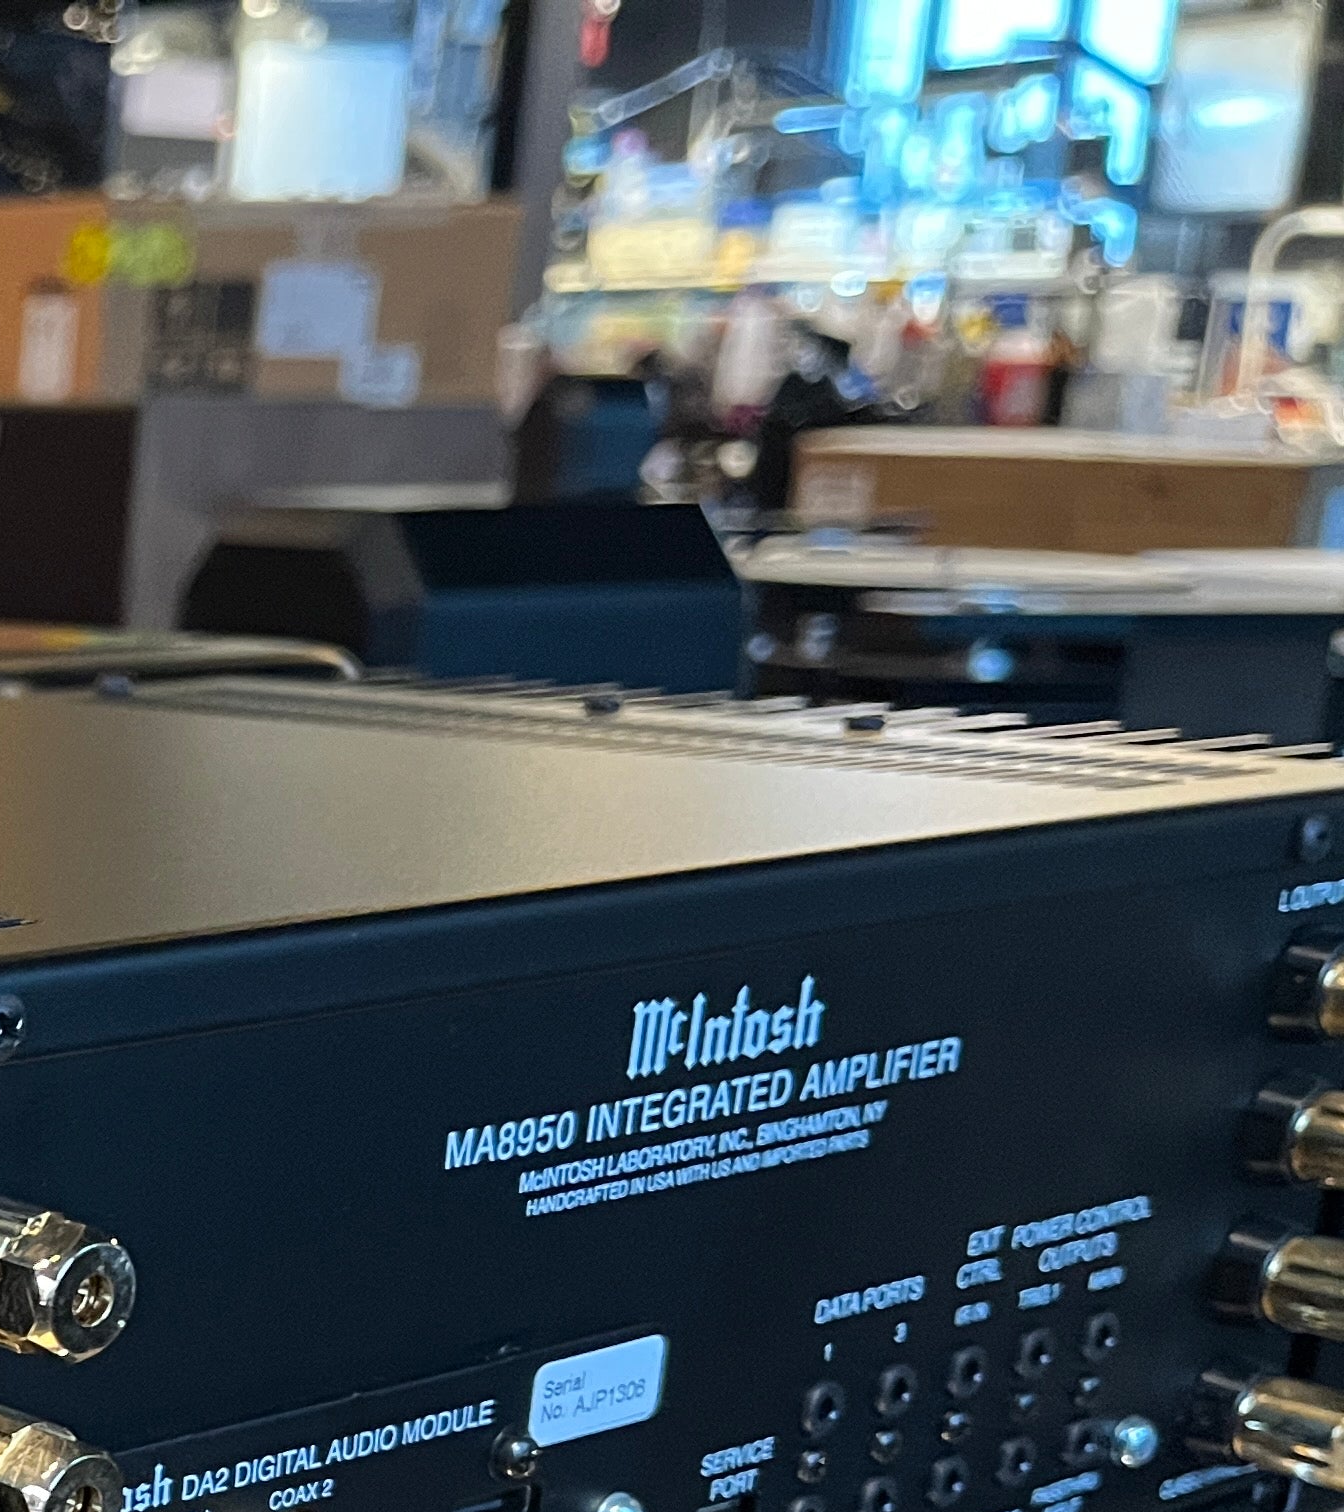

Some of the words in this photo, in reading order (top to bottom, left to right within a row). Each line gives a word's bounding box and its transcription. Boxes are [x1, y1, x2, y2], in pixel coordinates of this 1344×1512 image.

[625, 973, 826, 1080] McIntosh
[444, 1114, 578, 1171] MA8950
[585, 1068, 793, 1144] INTEGRATED
[799, 1037, 962, 1101] AMPLIFIER
[518, 1157, 605, 1194] McINTOSH
[525, 1179, 629, 1217] HANDCRAFTED
[629, 1176, 645, 1196] IN
[647, 1170, 675, 1192] USA
[544, 1370, 588, 1399] Serial
[181, 1467, 230, 1501] DA2
[234, 1444, 322, 1488] DIGITAL
[324, 1424, 398, 1466] AUDIO
[400, 1399, 496, 1445] MODULE
[269, 1481, 318, 1511] COAX
[320, 1477, 336, 1498] 2
